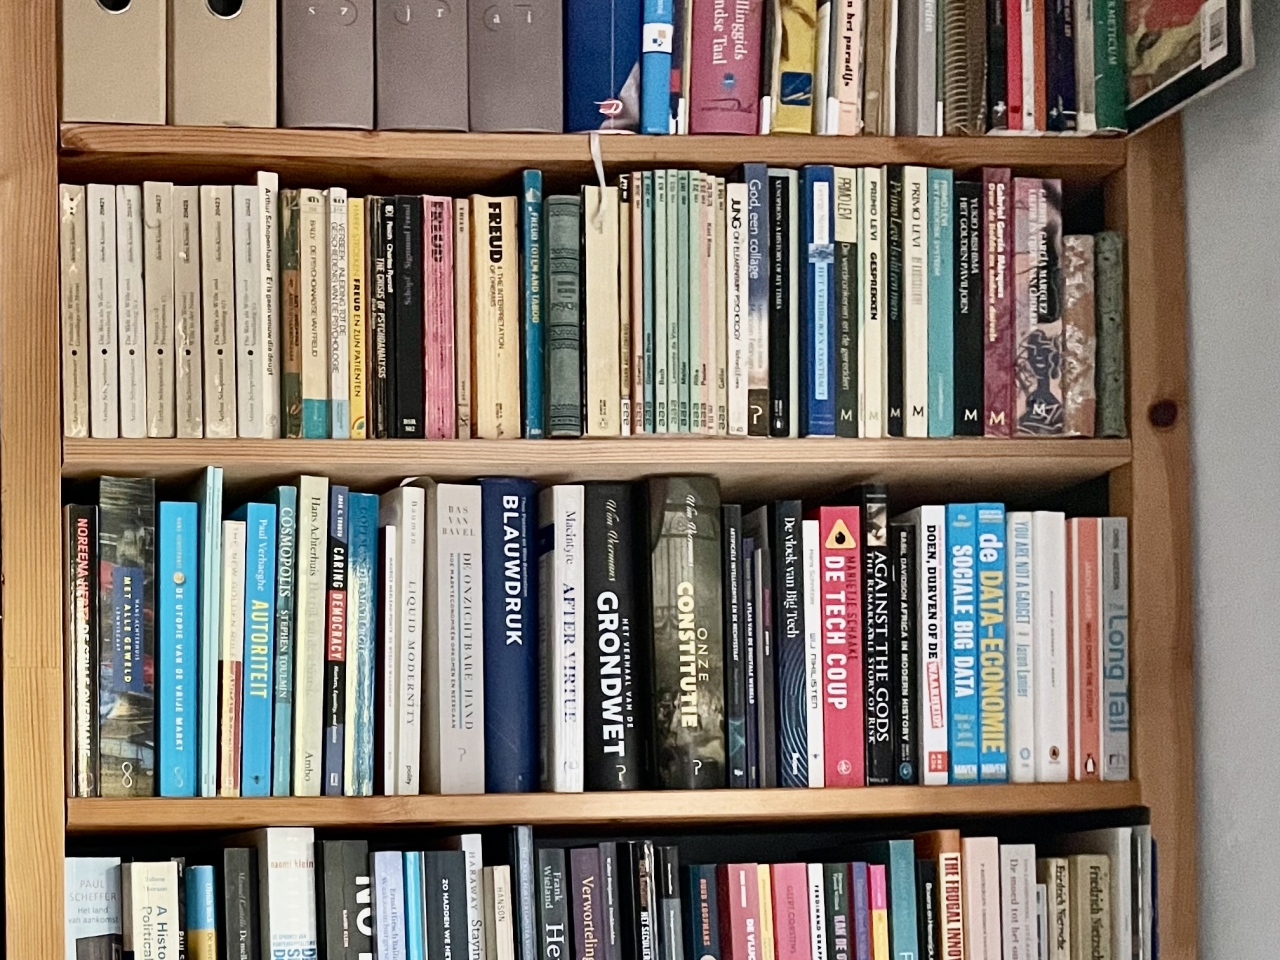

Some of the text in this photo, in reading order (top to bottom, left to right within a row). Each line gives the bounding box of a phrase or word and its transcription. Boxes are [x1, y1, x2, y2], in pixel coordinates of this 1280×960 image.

[488, 202, 502, 263] FREUD
[530, 213, 539, 240] FREUD
[748, 179, 760, 279] God, een collage
[531, 275, 539, 292] AND
[870, 252, 878, 320] GESPREKKEN
[309, 497, 321, 577] Hans Achterhuis
[503, 495, 522, 645] BLAUWDRUK
[250, 519, 269, 698] Paul Verhaeghe AUTORITEIT
[331, 547, 344, 659] CARING DEMOCRACY
[677, 581, 697, 728] CONSTITUTIE
[696, 628, 708, 682] ONZE
[825, 556, 847, 710] DE TECH COUP
[875, 551, 889, 742] AGAINST THE GODS
[952, 545, 974, 698] SOCIALE BIG DATA
[980, 533, 1005, 753] de DATA-ECONOMIE
[597, 591, 625, 757] GRONDWET
[1104, 615, 1128, 732] Long Tail
[303, 751, 314, 782] Ambo
[945, 856, 959, 877] THE
[945, 880, 960, 924] FRUGAL
